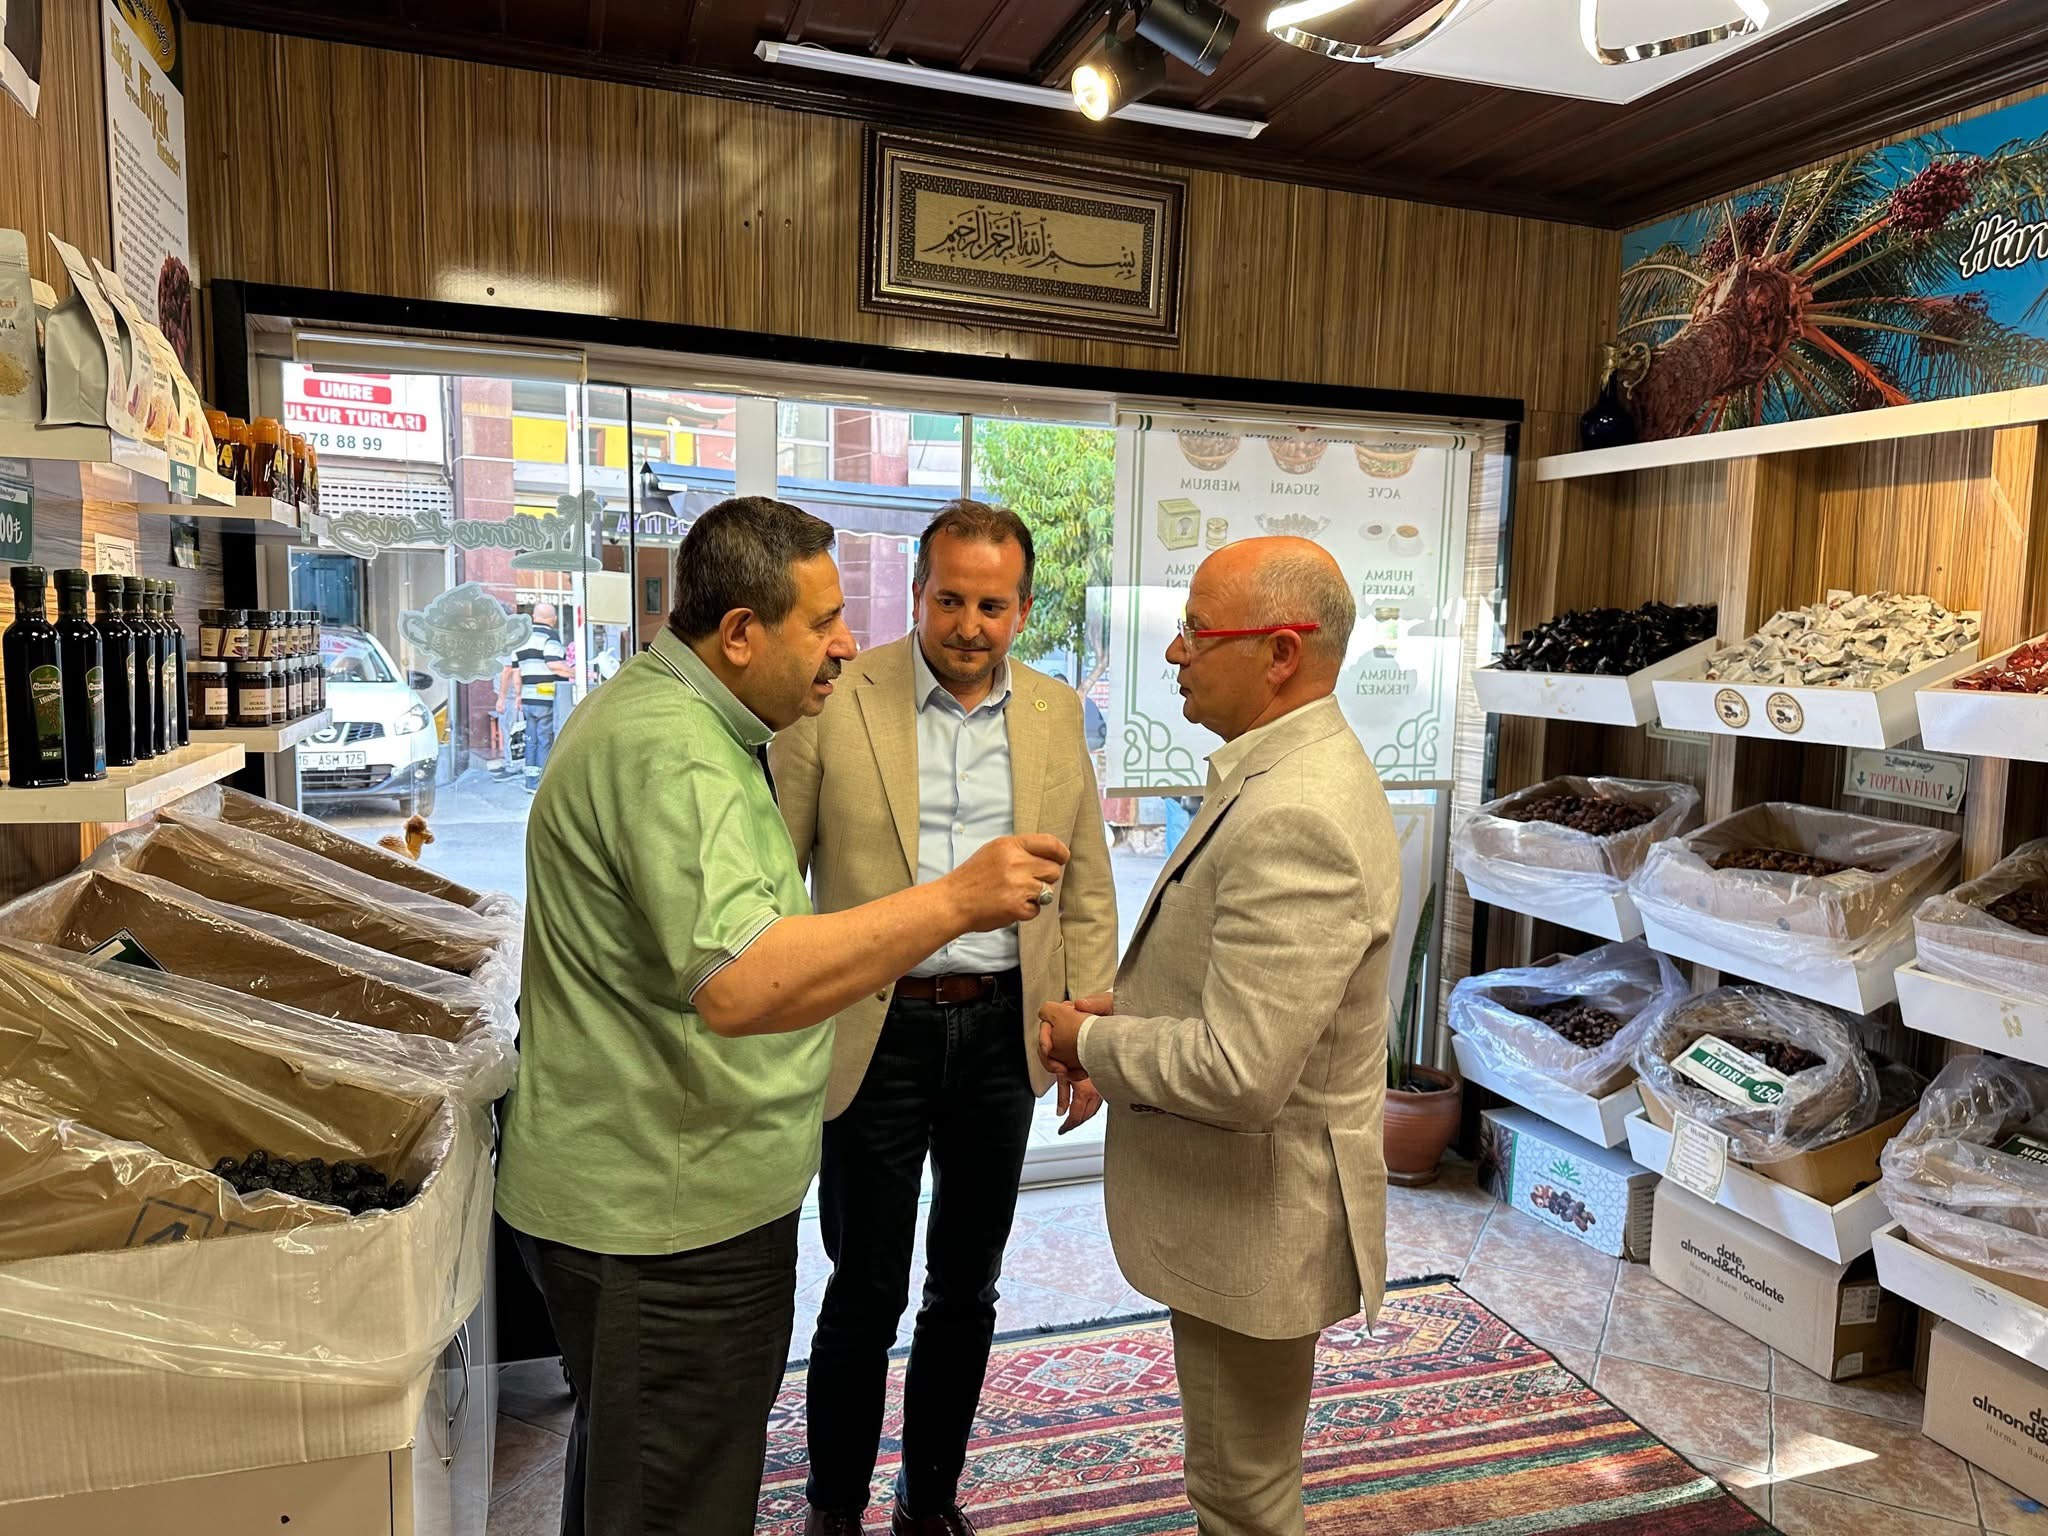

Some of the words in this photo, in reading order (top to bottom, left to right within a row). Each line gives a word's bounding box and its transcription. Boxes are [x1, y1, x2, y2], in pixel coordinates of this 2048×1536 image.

[319, 381, 374, 401] UMRE
[285, 404, 342, 424] ULTUR
[345, 409, 421, 430] TURLARI
[336, 435, 356, 449] 88
[362, 437, 382, 451] 99
[318, 754, 340, 766] ASM
[345, 753, 363, 765] 175
[1869, 771, 1912, 793] TOPTAN
[1913, 774, 1946, 801] FİYAT
[1716, 1244, 1746, 1270] date,
[1680, 1239, 1785, 1304] almond&chocolate
